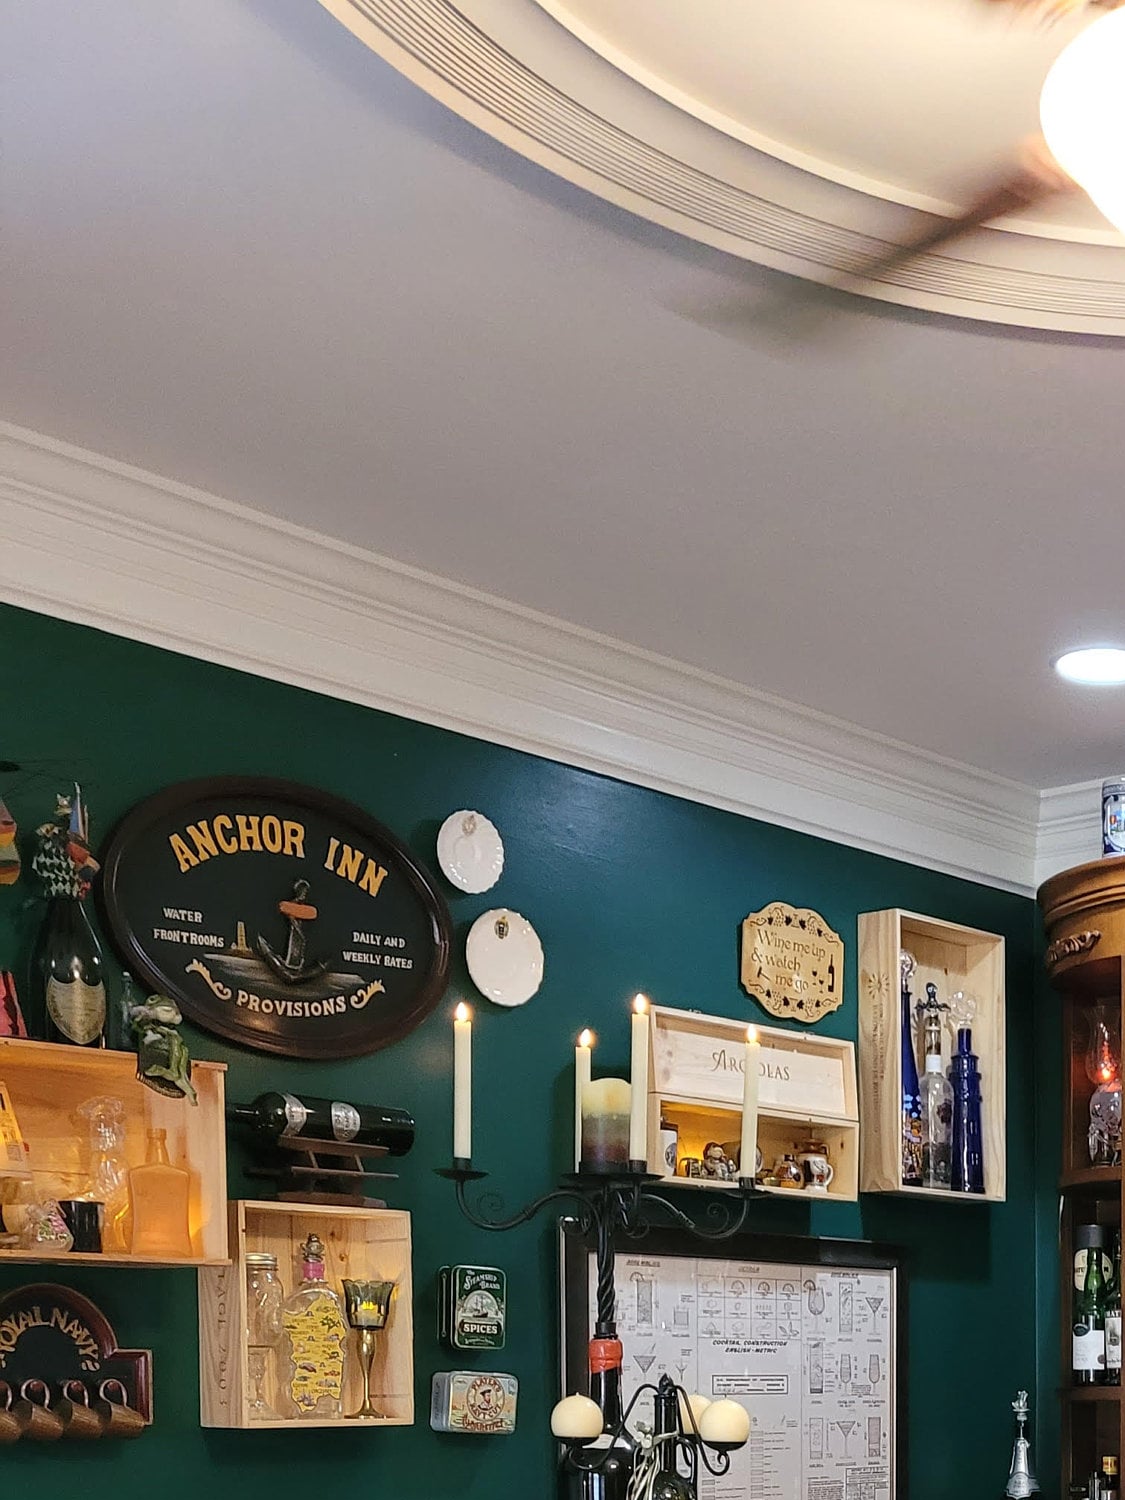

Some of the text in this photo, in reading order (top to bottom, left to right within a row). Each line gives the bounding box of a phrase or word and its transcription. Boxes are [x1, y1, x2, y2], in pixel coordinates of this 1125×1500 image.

[168, 815, 389, 898] ANCHOR INN
[162, 907, 203, 924] WATER
[352, 931, 407, 949] DAILY AND
[757, 929, 826, 962] Wine me up
[342, 951, 413, 970] WEEKLY RATES
[775, 974, 809, 994] me go
[235, 989, 348, 1019] PROVISIONS
[711, 1049, 790, 1081] AROLAS
[0, 1304, 99, 1360] OYAL NAVY
[463, 1323, 498, 1335] SPICES
